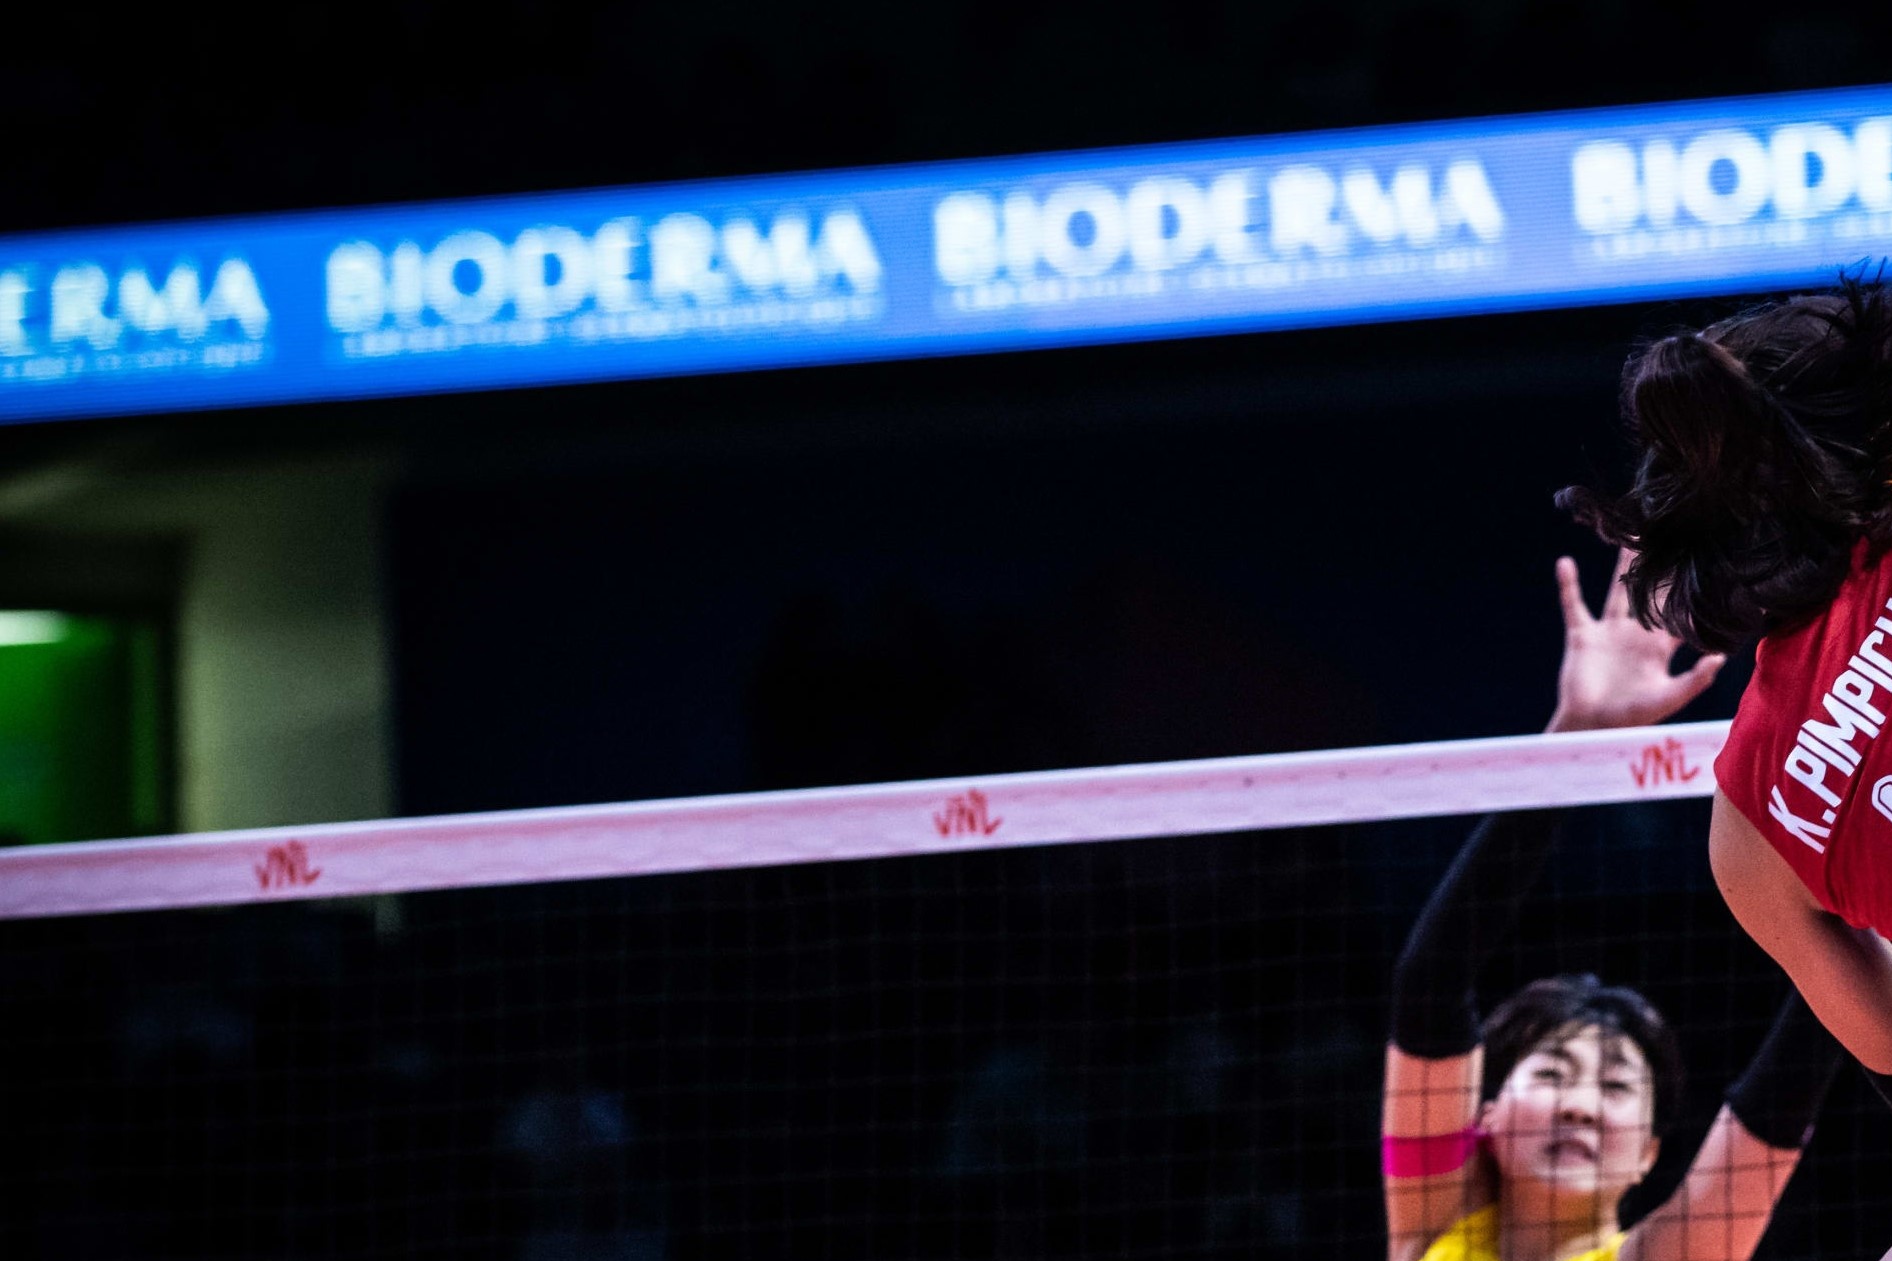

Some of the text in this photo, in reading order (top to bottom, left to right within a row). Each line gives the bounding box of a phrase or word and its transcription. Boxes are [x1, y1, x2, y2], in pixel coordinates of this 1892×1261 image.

[0, 255, 270, 356] ERMA
[325, 211, 883, 333] BIODERMA
[933, 157, 1505, 287] BIODERMA
[933, 787, 1003, 838] VNL
[1630, 737, 1701, 788] VNL
